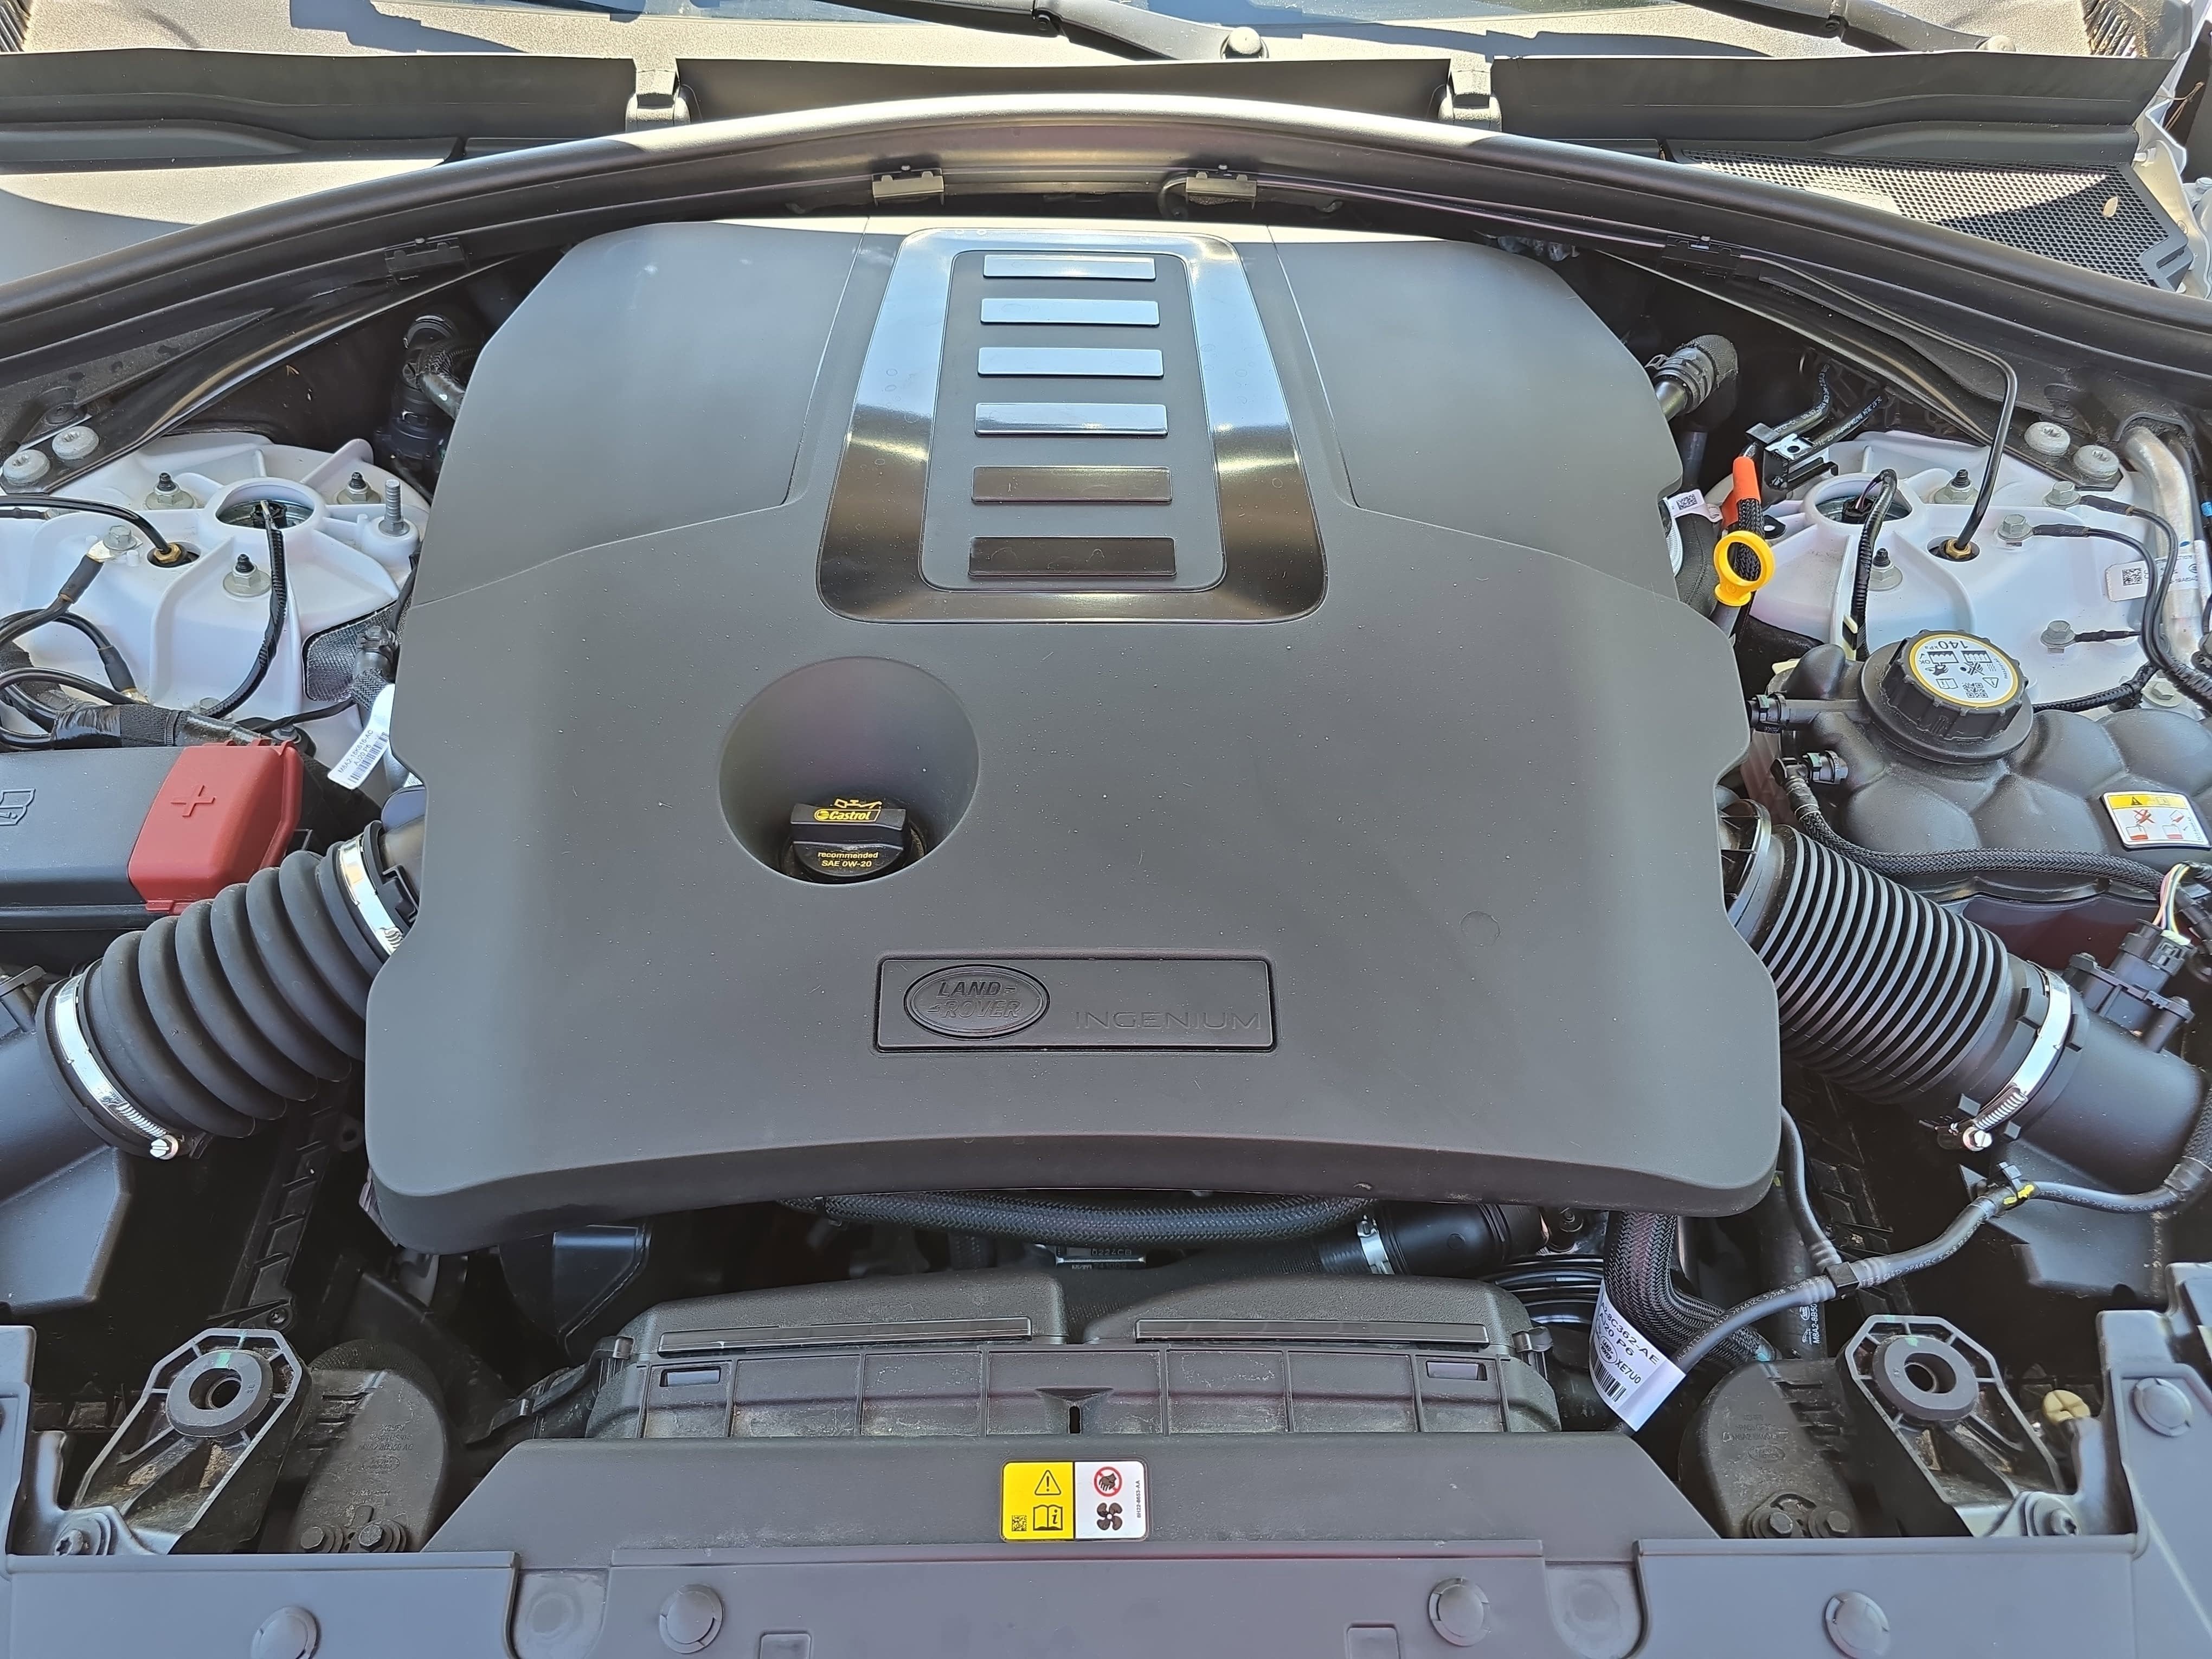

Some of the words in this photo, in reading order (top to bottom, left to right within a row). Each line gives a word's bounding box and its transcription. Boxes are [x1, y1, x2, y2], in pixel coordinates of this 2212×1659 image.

[1938, 640, 1968, 650] 140
[829, 811, 872, 820] Castrol
[936, 980, 1002, 998] LAND
[941, 999, 1021, 1018] ROVER
[1076, 1012, 1261, 1030] INGENIUM
[1730, 1298, 1763, 1315] >PA612<
[1600, 1300, 1660, 1365] A2-8C362-AE
[1600, 1344, 1612, 1361] ROVER
[1602, 1339, 1611, 1352] LAND
[1616, 1338, 1634, 1356] P6
